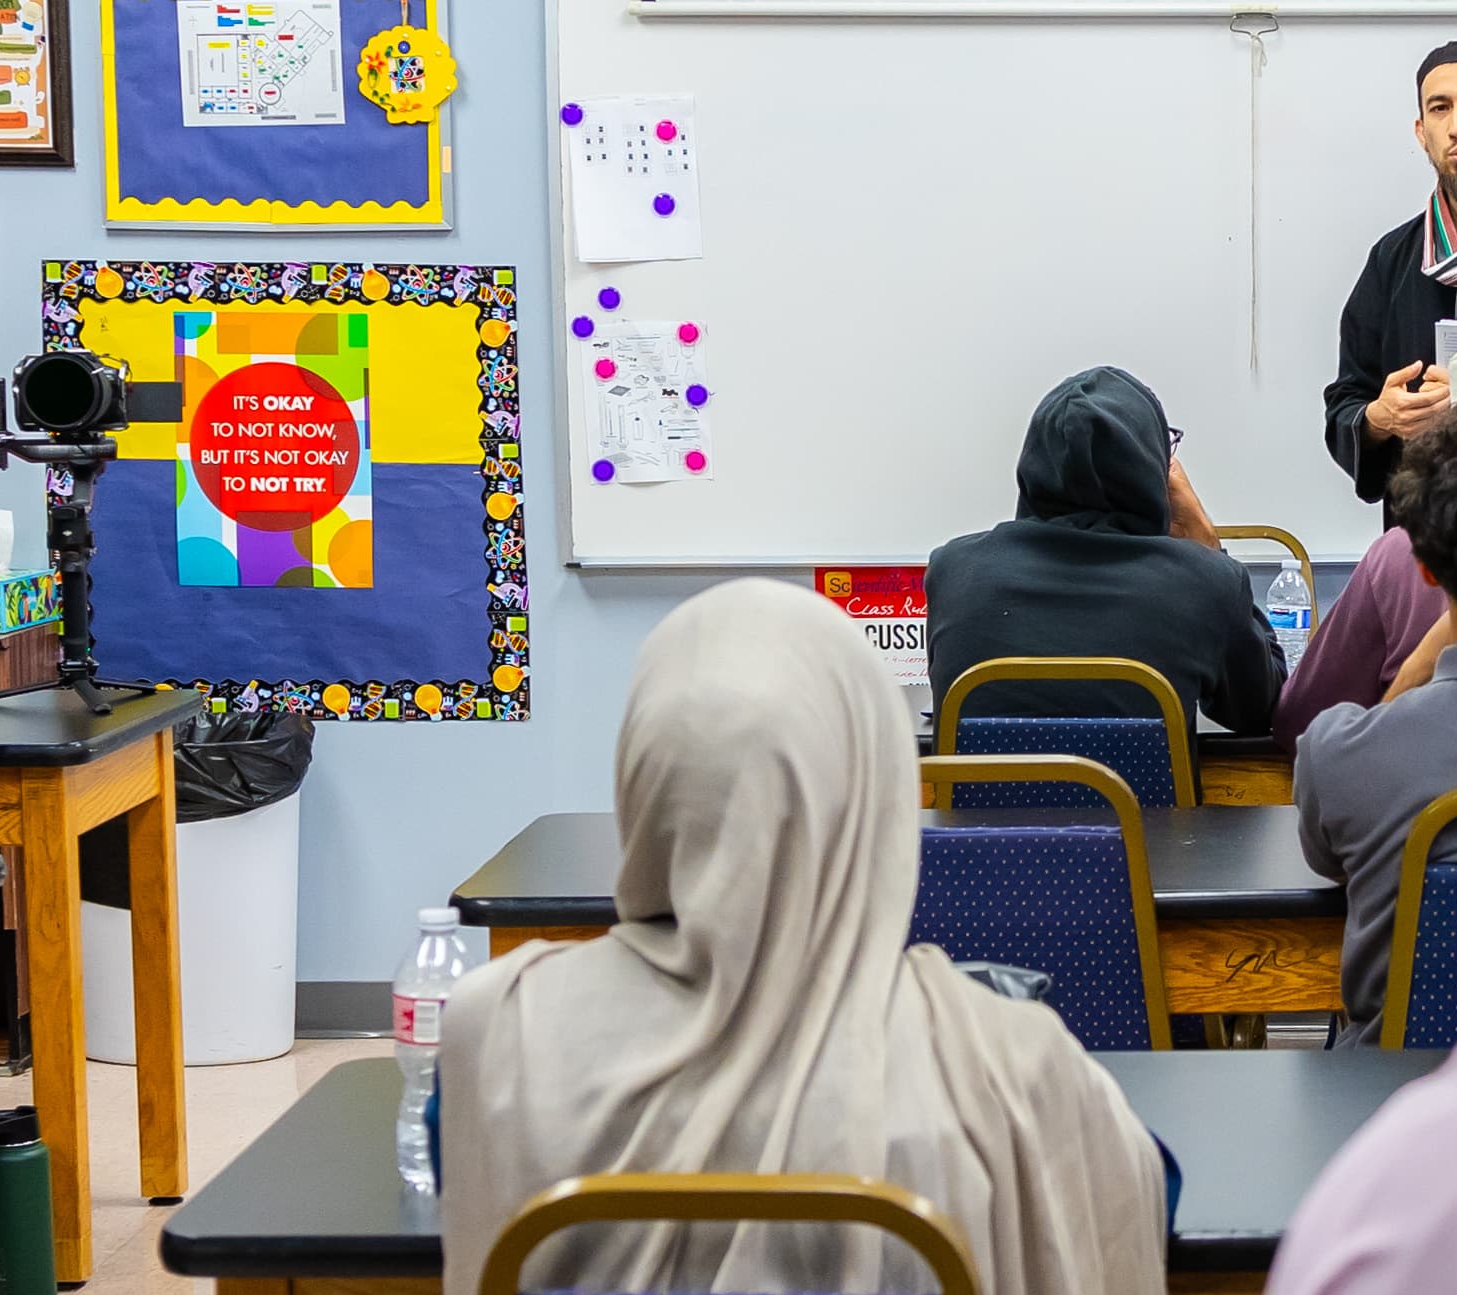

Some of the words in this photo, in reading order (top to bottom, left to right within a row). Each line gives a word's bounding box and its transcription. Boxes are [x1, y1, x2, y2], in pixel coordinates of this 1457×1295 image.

[233, 395, 259, 411] IT'S
[262, 395, 315, 411] OKAY
[210, 422, 234, 438] TO
[238, 423, 275, 438] NOT
[279, 423, 337, 440] KNOW,
[200, 449, 230, 465] BUT
[233, 449, 260, 465] IT'S
[264, 450, 301, 465] NOT
[304, 450, 349, 465] OKAY
[222, 476, 246, 492] TO
[250, 477, 289, 492] NOT
[293, 477, 327, 493] TRY.
[846, 596, 895, 616] Class
[899, 596, 928, 616] Rul
[865, 624, 925, 650] CUSSI
